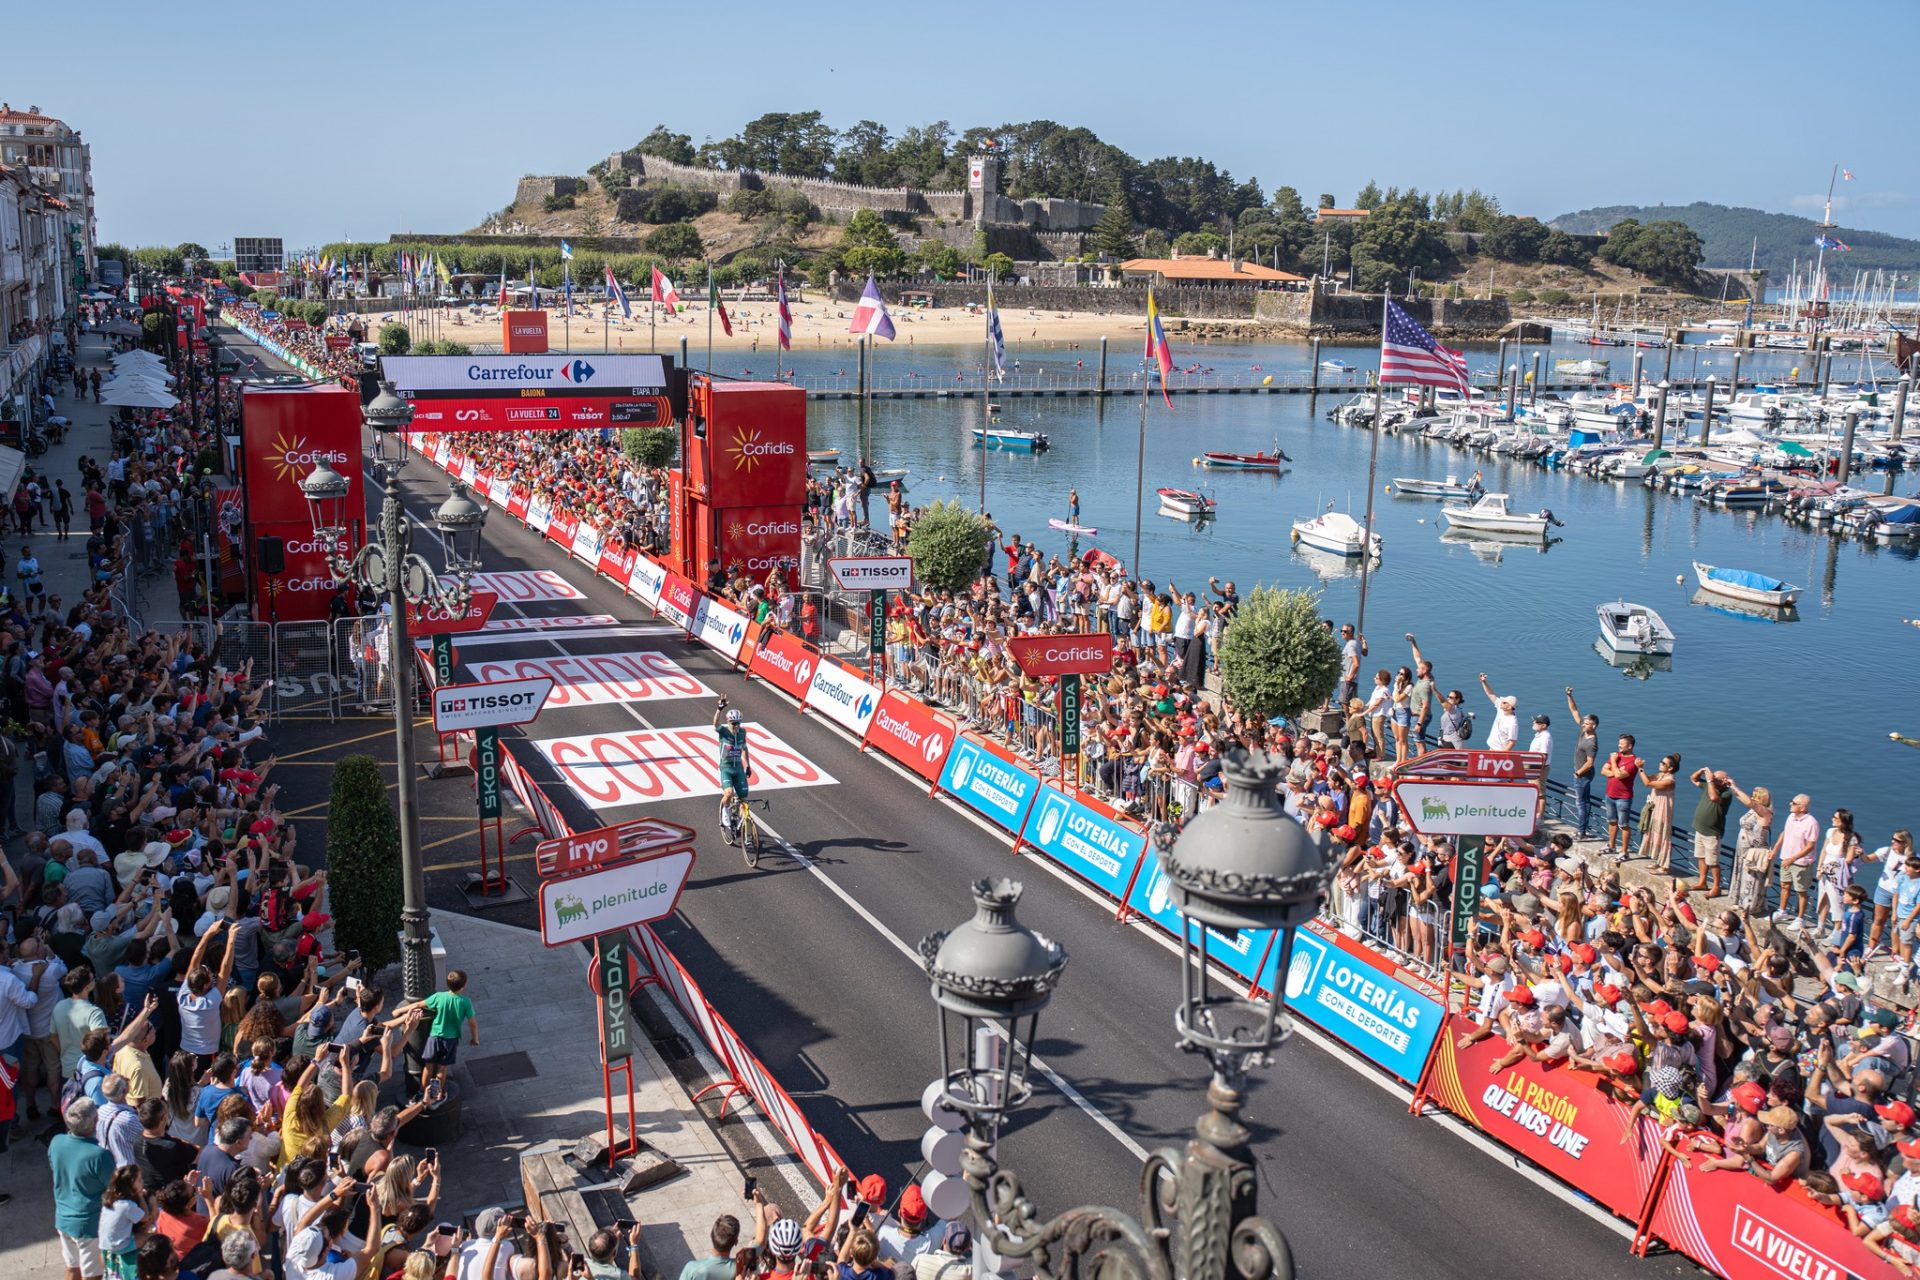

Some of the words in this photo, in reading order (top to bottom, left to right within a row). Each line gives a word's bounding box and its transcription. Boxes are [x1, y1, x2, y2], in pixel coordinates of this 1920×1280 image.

[468, 364, 554, 380] Carrefour
[397, 390, 416, 400] META
[521, 389, 546, 398] BAIONA
[632, 388, 650, 396] ETAPA
[652, 387, 660, 395] 10
[510, 410, 518, 418] LA
[520, 410, 544, 418] VUELTA
[548, 410, 557, 418] 24
[743, 442, 794, 456] Cofidis
[747, 522, 798, 534] Cofidis
[860, 567, 908, 576] TISSOT
[674, 588, 692, 609] Cofidis
[696, 607, 728, 635] Carrefour
[438, 641, 450, 686] KODA
[756, 644, 794, 673] Carrefour
[1046, 647, 1104, 662] Cofidis
[468, 692, 534, 710] TISSOT
[813, 672, 854, 706] Carrefour
[876, 708, 922, 748] Carrefour
[1478, 754, 1514, 775] iryo
[976, 760, 1026, 798] LOTERÍAS
[991, 792, 1016, 809] DEPORTE
[1454, 802, 1527, 818] plenitude
[1068, 812, 1130, 858] LOTERÍAS
[568, 838, 608, 862] iryo
[1066, 837, 1078, 848] CON
[1086, 849, 1116, 872] DEPORTE
[592, 882, 668, 914] plenitude
[1325, 960, 1420, 1029] LOTERÍAS
[1325, 993, 1344, 1010] CON
[1346, 1006, 1356, 1018] EL
[1358, 1012, 1401, 1045] DEPORTE
[1506, 1071, 1526, 1099] LA
[1525, 1081, 1578, 1128] PASIÓN
[1482, 1084, 1520, 1118] QUE
[1514, 1103, 1551, 1138] NOS
[1549, 1122, 1590, 1160] UNE
[1740, 1219, 1765, 1252] LA
